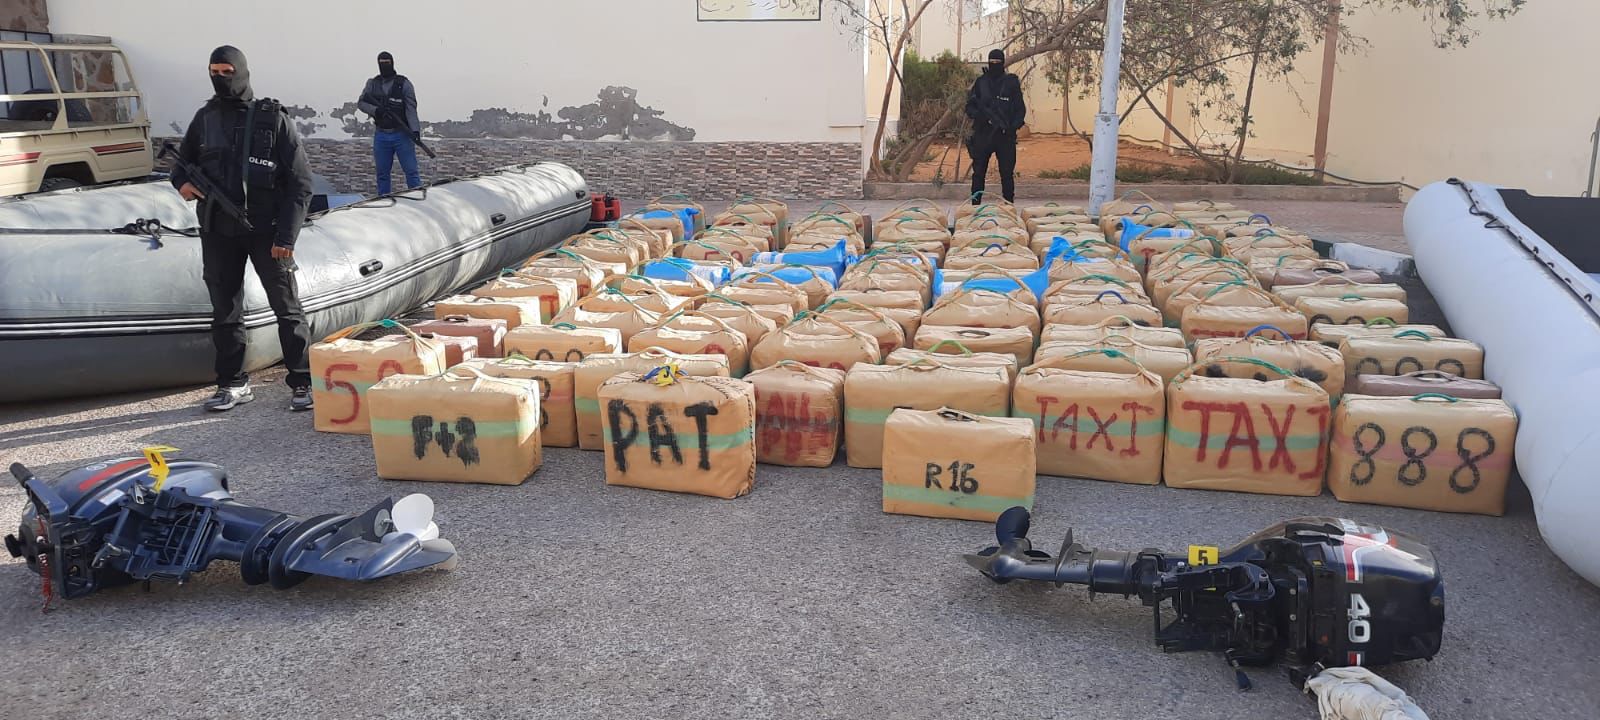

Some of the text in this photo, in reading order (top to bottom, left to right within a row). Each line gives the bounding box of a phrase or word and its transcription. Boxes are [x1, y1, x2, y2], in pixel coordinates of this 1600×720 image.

[248, 156, 276, 168] OLICE
[607, 398, 718, 473] PAT
[1036, 396, 1154, 457] TAXI
[1351, 422, 1496, 494] 888
[1198, 549, 1208, 565] 5
[1347, 592, 1372, 645] 40
